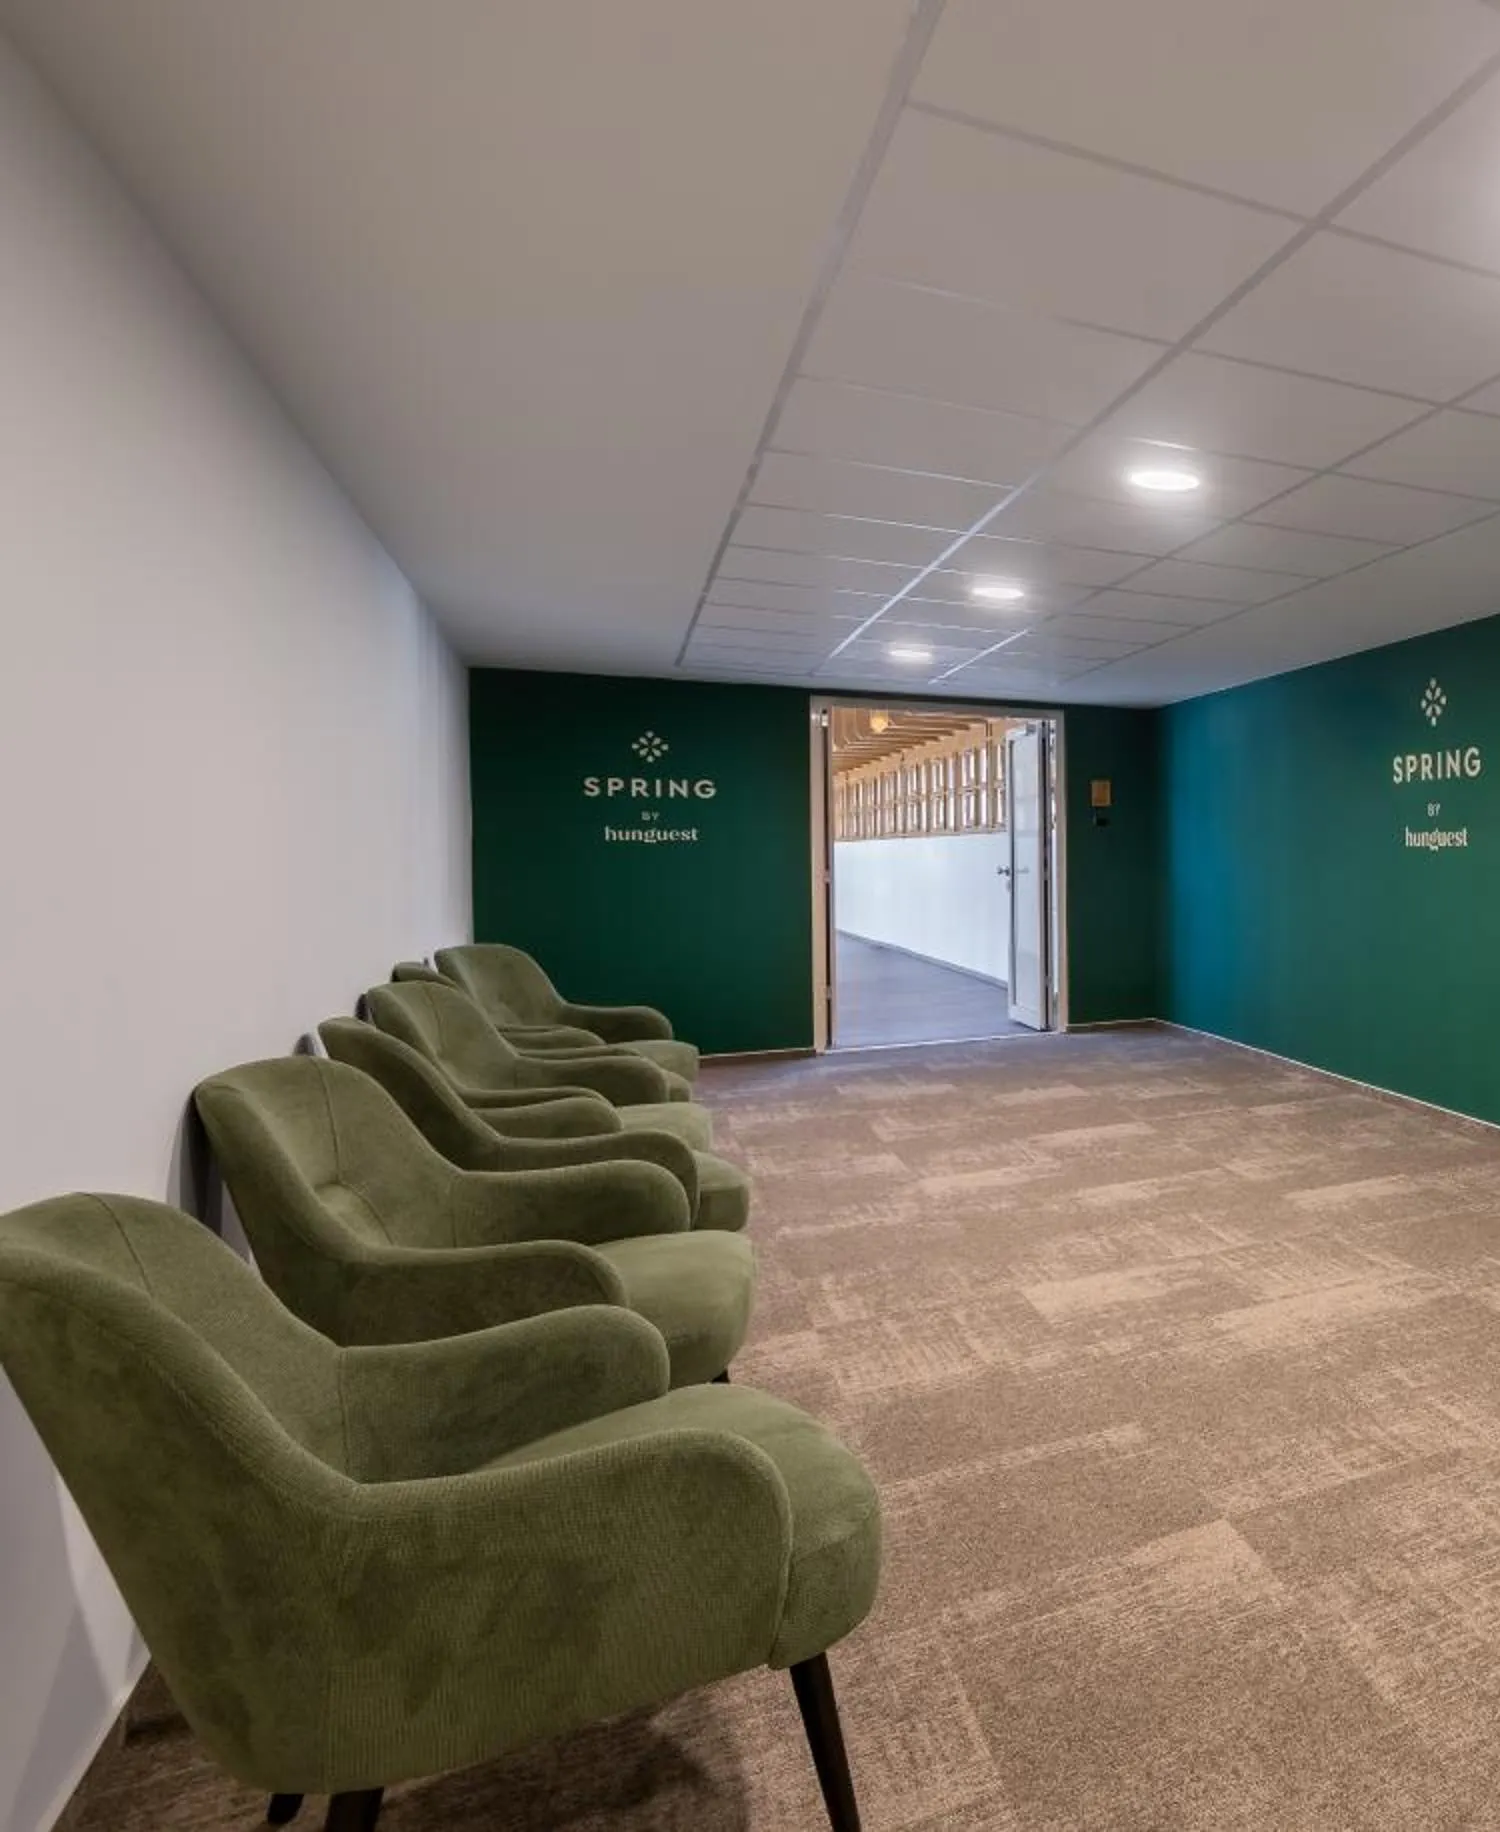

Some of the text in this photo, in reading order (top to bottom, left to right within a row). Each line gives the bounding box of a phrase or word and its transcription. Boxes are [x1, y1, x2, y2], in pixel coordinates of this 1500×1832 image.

[1393, 746, 1481, 785] SPRING
[584, 777, 717, 799] SPRING
[641, 811, 660, 821] BY
[1427, 802, 1441, 817] BY
[604, 826, 698, 844] hunguest
[1405, 826, 1468, 851] hunguest
